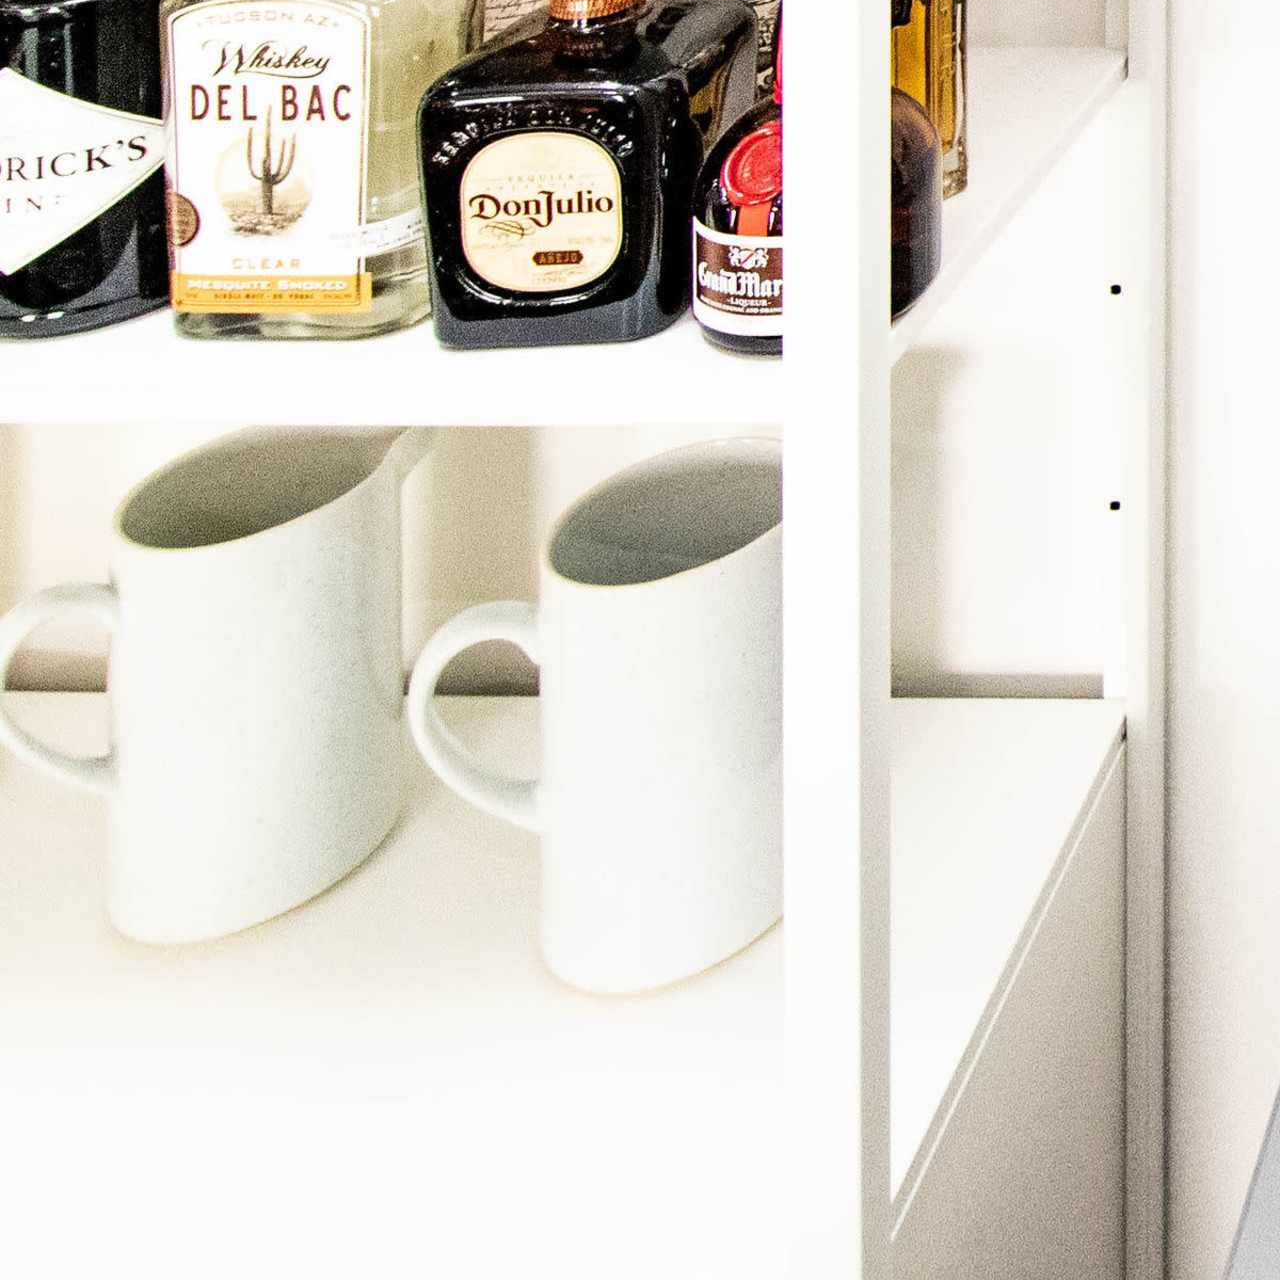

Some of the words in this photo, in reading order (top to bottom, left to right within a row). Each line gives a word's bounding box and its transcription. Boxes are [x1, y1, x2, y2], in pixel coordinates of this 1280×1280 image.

[201, 38, 332, 79] Whiskey
[190, 83, 258, 121] DEL
[281, 83, 352, 121] BAC
[0, 135, 149, 182] RICK'S
[231, 257, 302, 270] CLEAR
